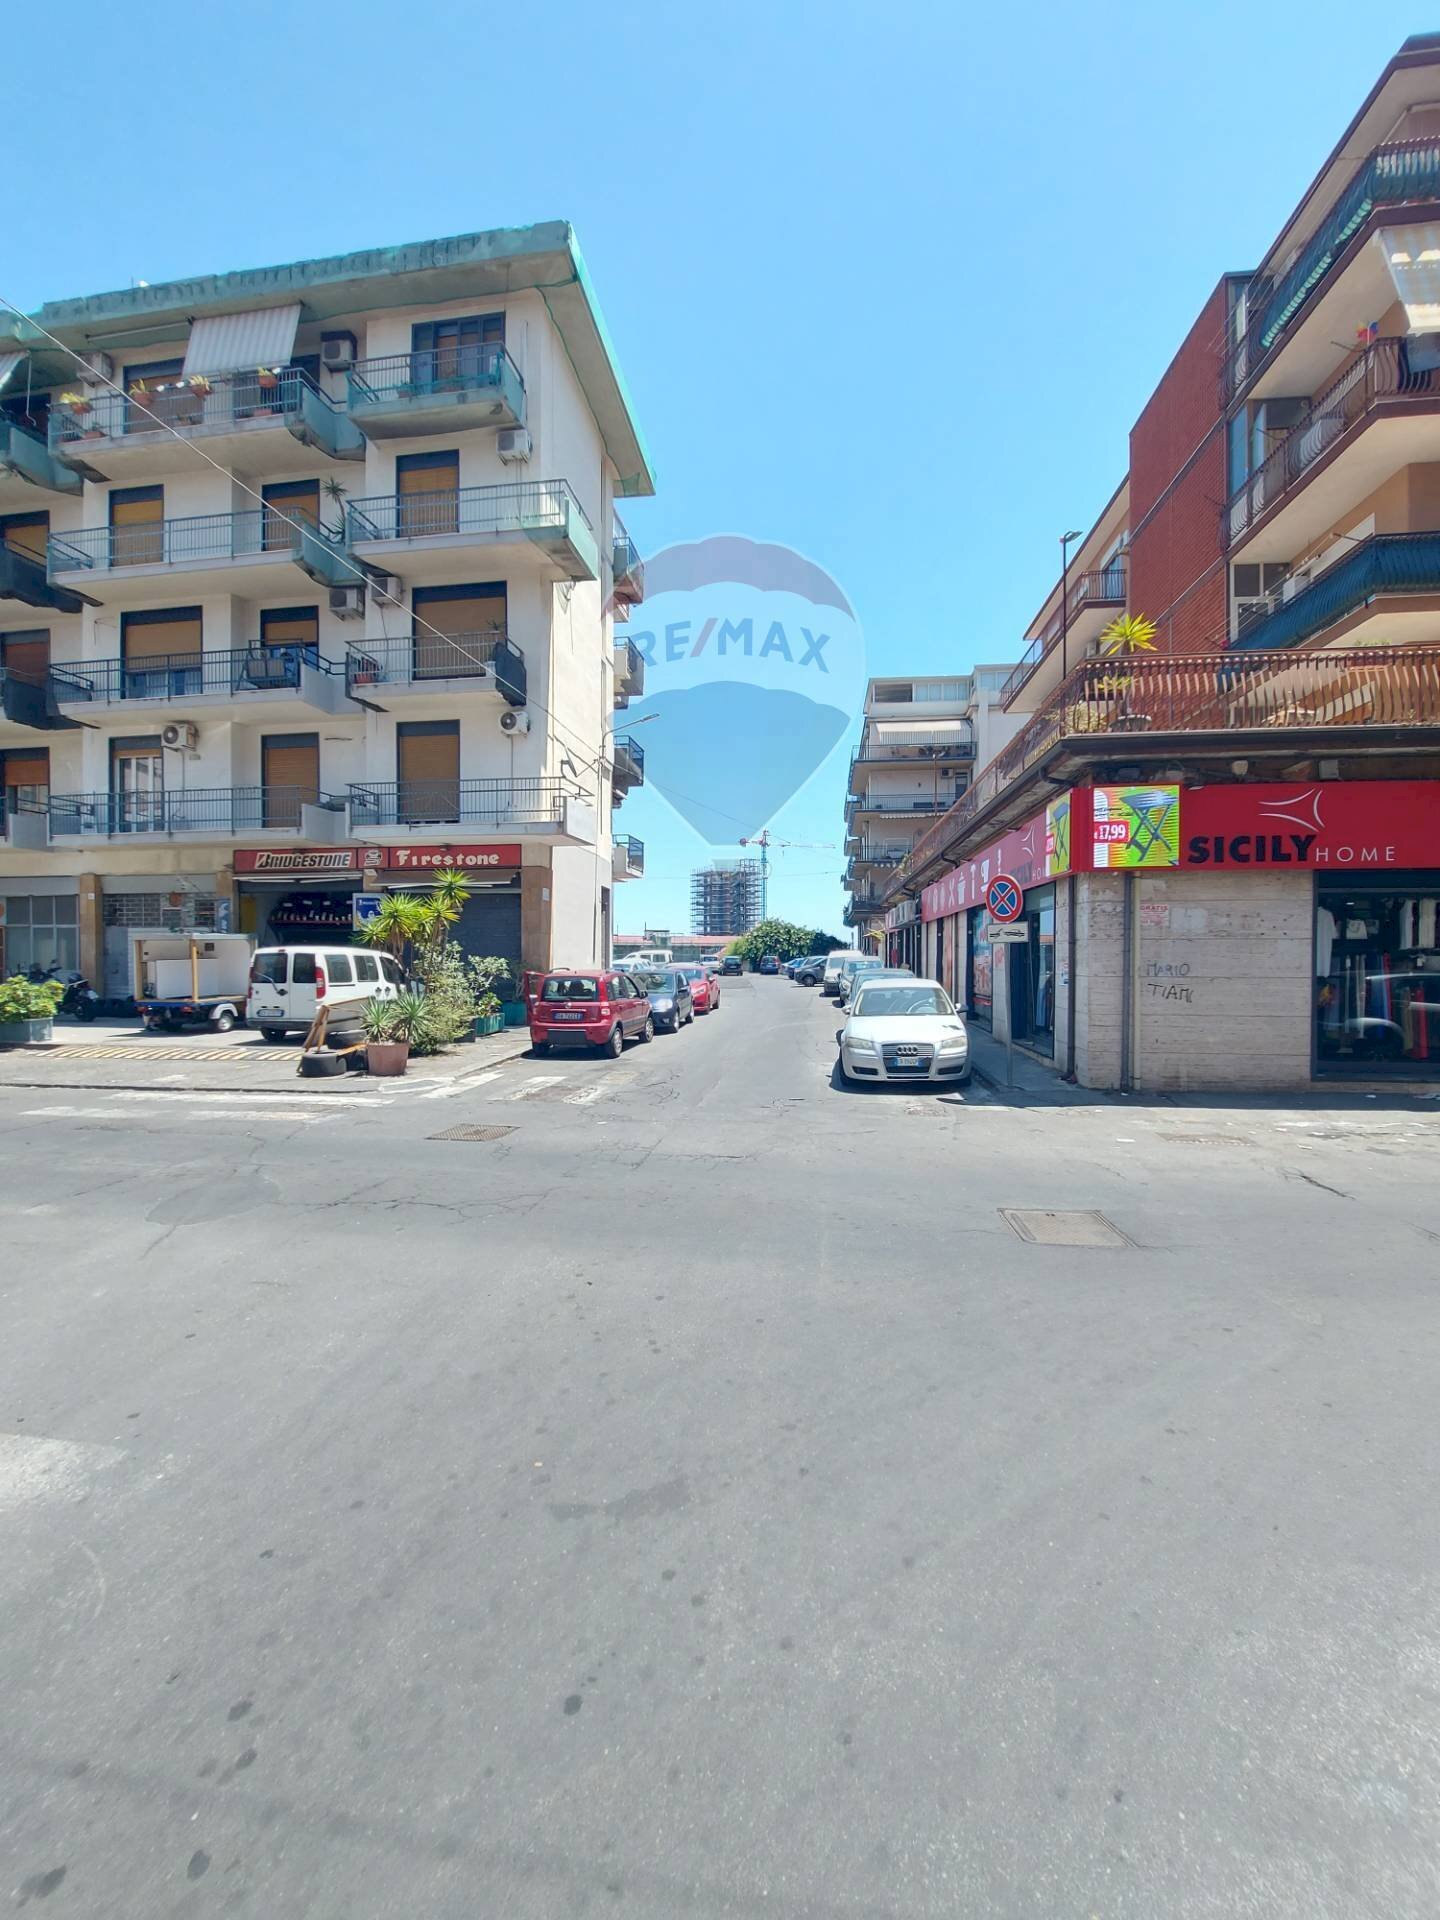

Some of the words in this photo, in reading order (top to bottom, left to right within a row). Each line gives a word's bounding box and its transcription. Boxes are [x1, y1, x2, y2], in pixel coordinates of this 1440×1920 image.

[1187, 834, 1316, 863] SICILY
[1315, 846, 1396, 862] HOME
[256, 853, 351, 868] BRIDGESTONE
[396, 850, 500, 866] Firestone
